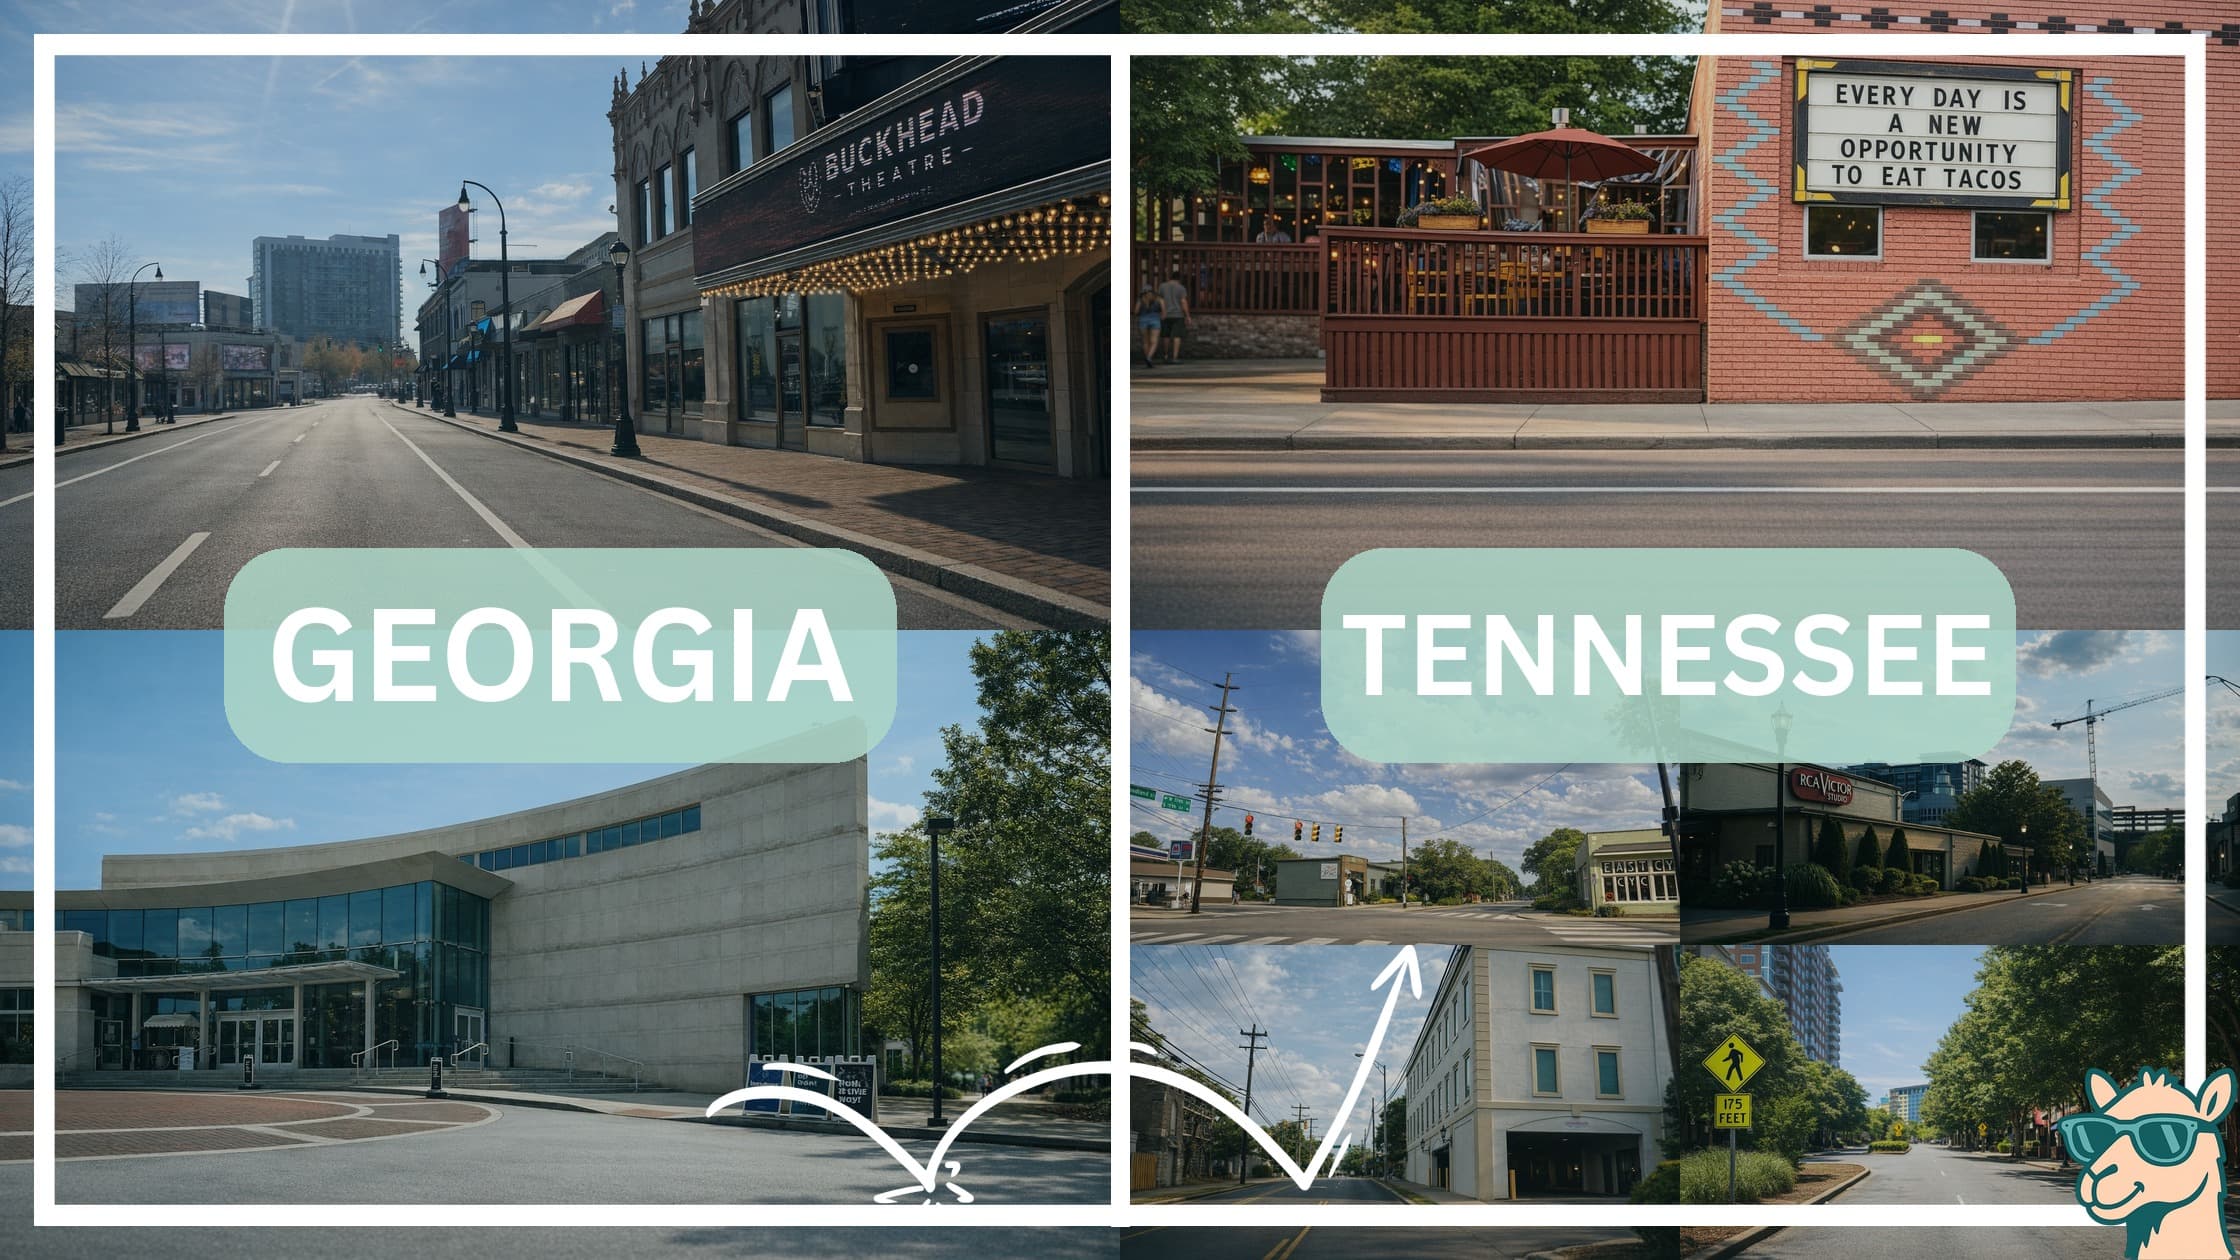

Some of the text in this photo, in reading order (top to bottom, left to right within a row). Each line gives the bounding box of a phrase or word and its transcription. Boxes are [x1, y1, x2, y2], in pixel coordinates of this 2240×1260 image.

[1836, 84, 2027, 111] EVERY DAY IS
[825, 90, 984, 181] BUCKHEAD
[1888, 113, 1982, 136] A NEW
[1840, 138, 2017, 164] OPPORTUNITY
[847, 146, 952, 196] THEATRE
[1831, 164, 2022, 190] TO EAT TACOS
[1800, 772, 1852, 797] RCA VICTOR
[1603, 860, 1646, 873] EAST
[1617, 876, 1648, 887] CYC
[1723, 1098, 1743, 1110] 175
[1719, 1112, 1747, 1124] FEET
